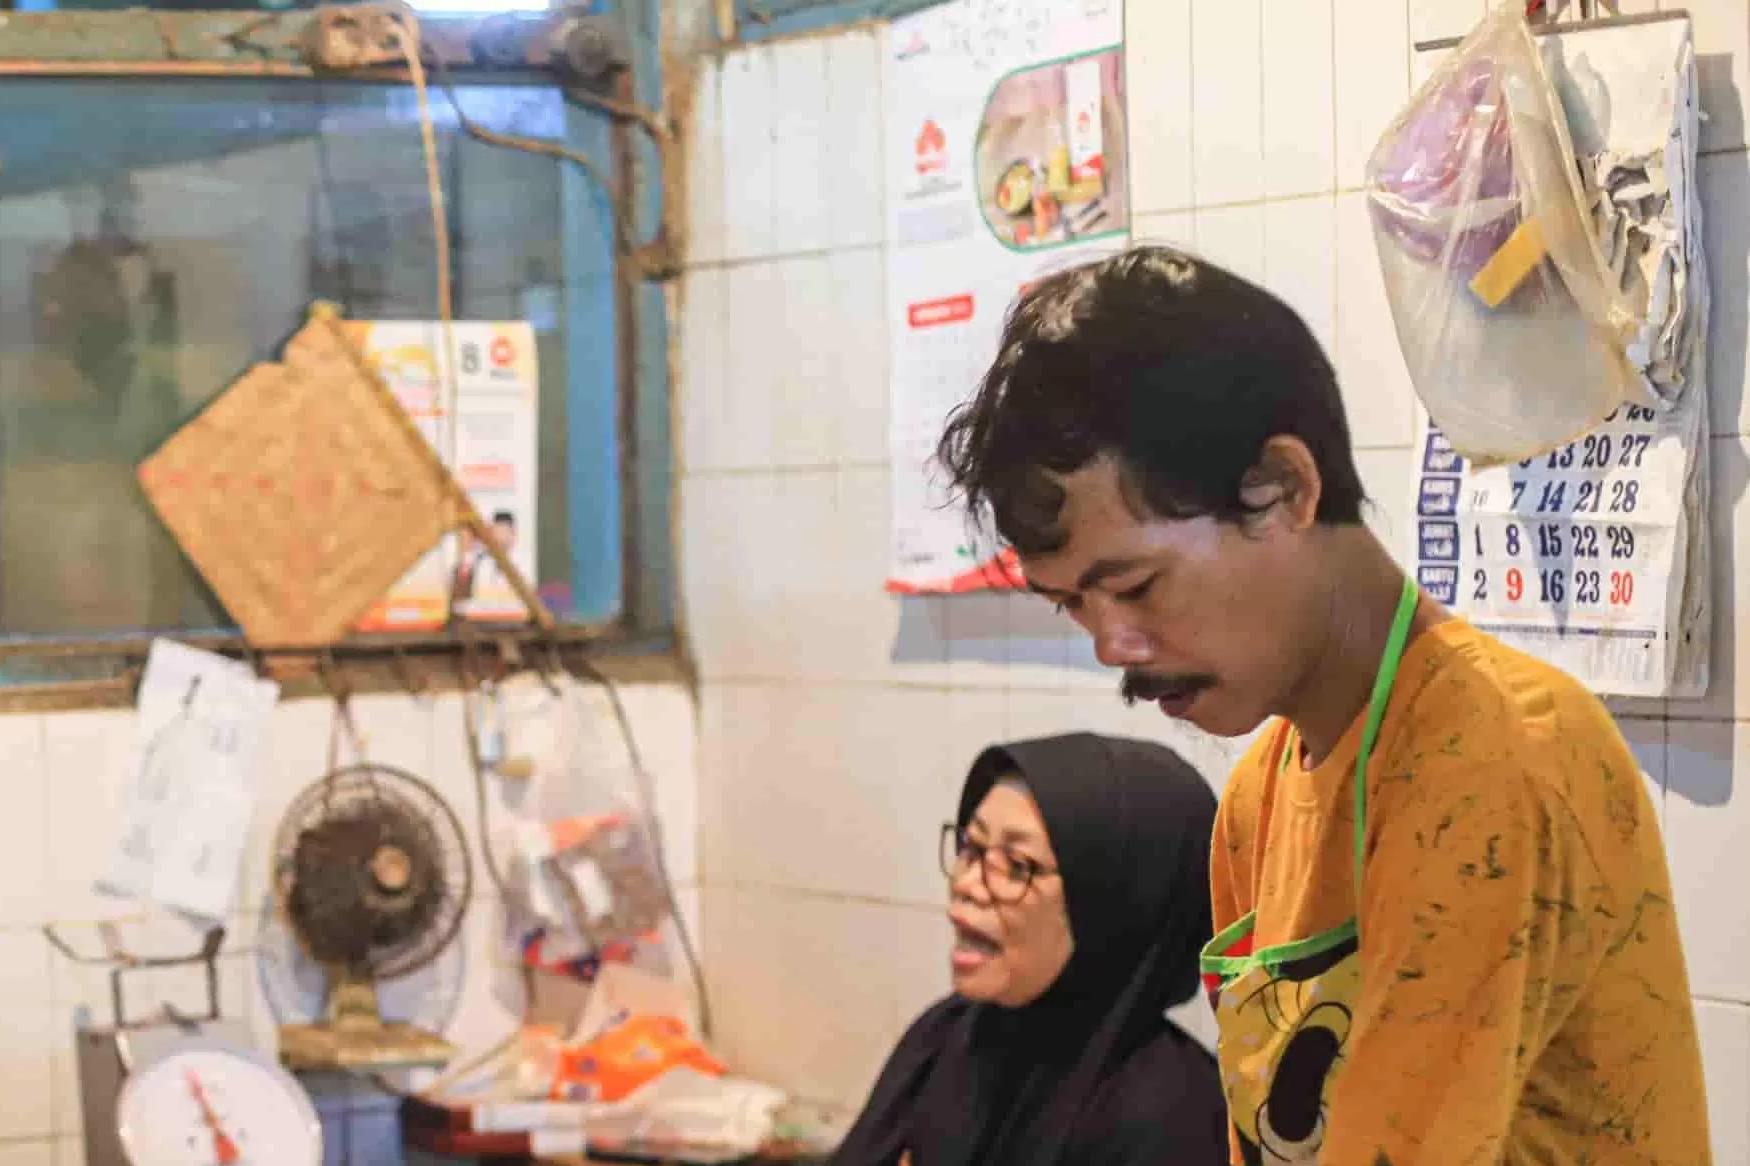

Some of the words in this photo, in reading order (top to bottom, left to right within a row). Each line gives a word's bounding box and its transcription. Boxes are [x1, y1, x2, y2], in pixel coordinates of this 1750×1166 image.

[1582, 433, 1612, 469] 20
[1618, 433, 1652, 468] 27
[1510, 480, 1527, 511] 7
[1536, 480, 1567, 513] 14
[1572, 479, 1603, 513] 21
[1609, 479, 1640, 514] 28
[1473, 523, 1484, 557] 1
[1504, 523, 1521, 557] 8
[1537, 523, 1563, 558] 15
[1570, 524, 1600, 559] 22
[1606, 524, 1635, 559] 29
[1473, 568, 1488, 600] 2
[1505, 566, 1524, 602] 9
[1538, 568, 1565, 604] 16
[1574, 570, 1601, 604] 23
[1609, 570, 1635, 606] 30
